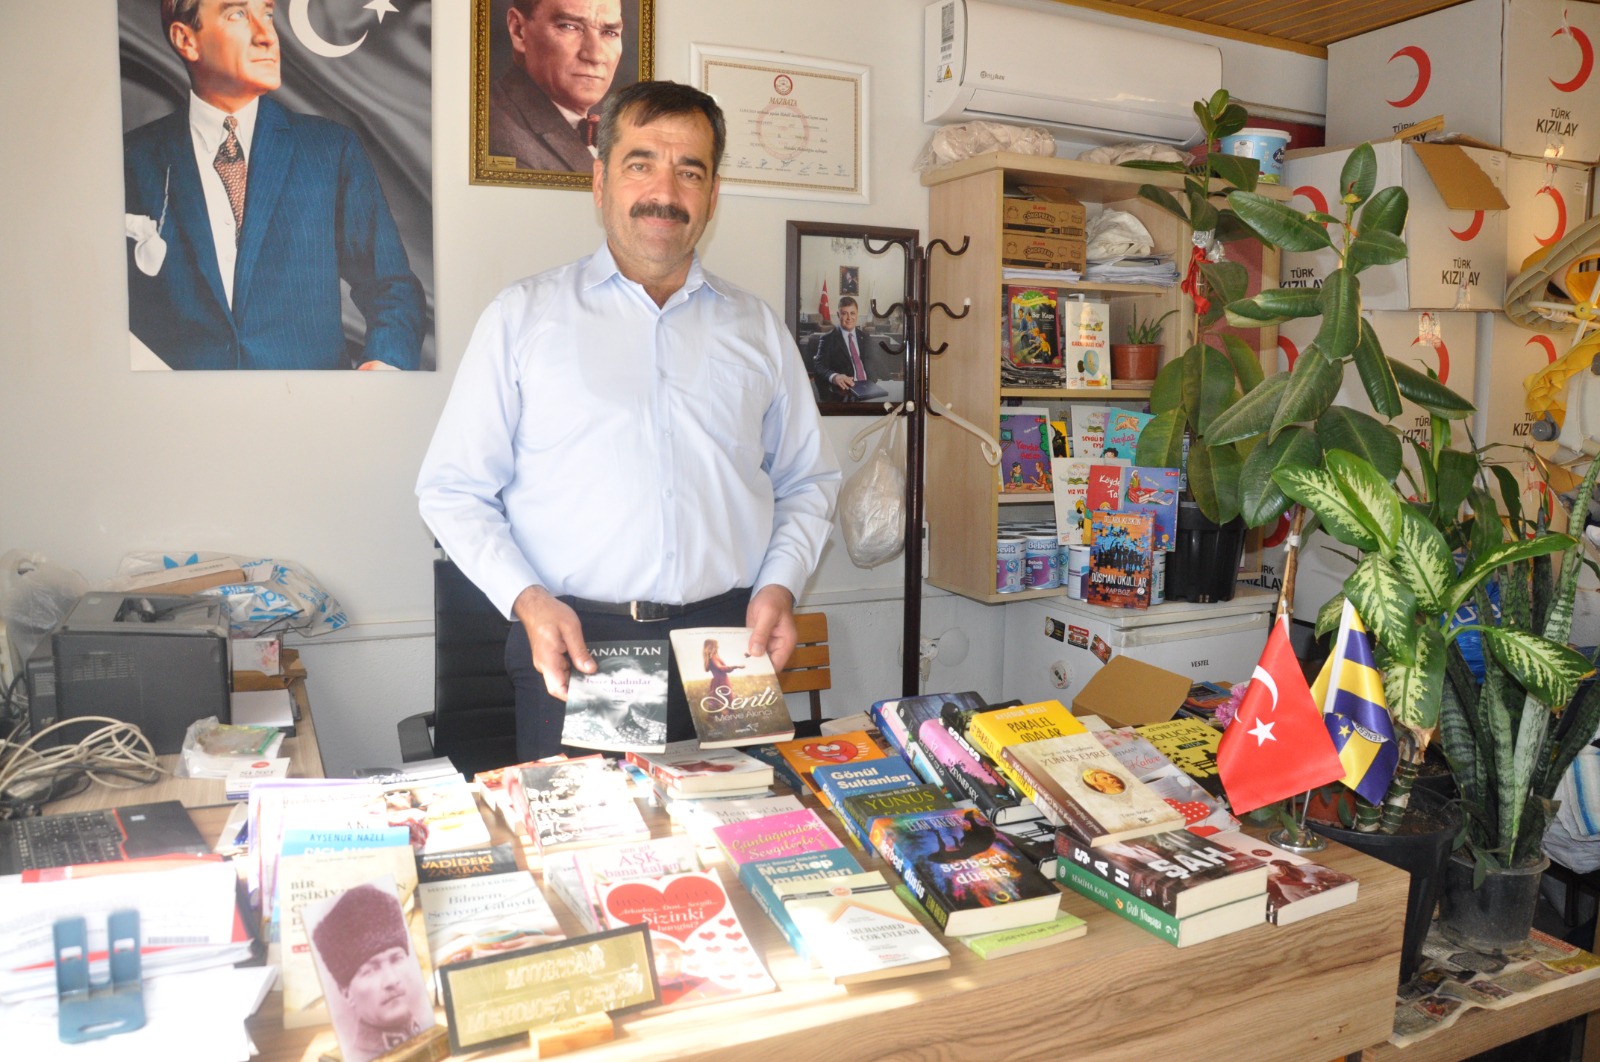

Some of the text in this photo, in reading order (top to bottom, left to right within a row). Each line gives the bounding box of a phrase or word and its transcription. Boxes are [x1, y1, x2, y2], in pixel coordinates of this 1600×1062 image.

[1551, 107, 1571, 120] TÜRK
[1536, 119, 1579, 137] KIZILAY
[1290, 266, 1314, 278] TÜRK
[1453, 259, 1471, 269] TÜRK
[1415, 417, 1431, 427] TÜR
[1028, 541, 1056, 550] Bebevit
[587, 646, 662, 656] ANAN TAN
[714, 713, 744, 722] Merve
[1007, 716, 1056, 733] PARALEL
[1020, 727, 1067, 743] ODALAR
[1146, 725, 1204, 743] SOLUCAN
[1041, 749, 1110, 767] YUNUS EMRE
[831, 767, 879, 781] Gönül
[836, 774, 912, 790] Sultanları
[864, 790, 935, 810] YUNUS
[758, 859, 834, 876] Mezhep
[939, 853, 1007, 873] serbest
[1148, 846, 1237, 880] ŞAH
[291, 880, 316, 890] BİR
[641, 907, 705, 925] Sizinki
[850, 922, 905, 934] MUHAMMED
